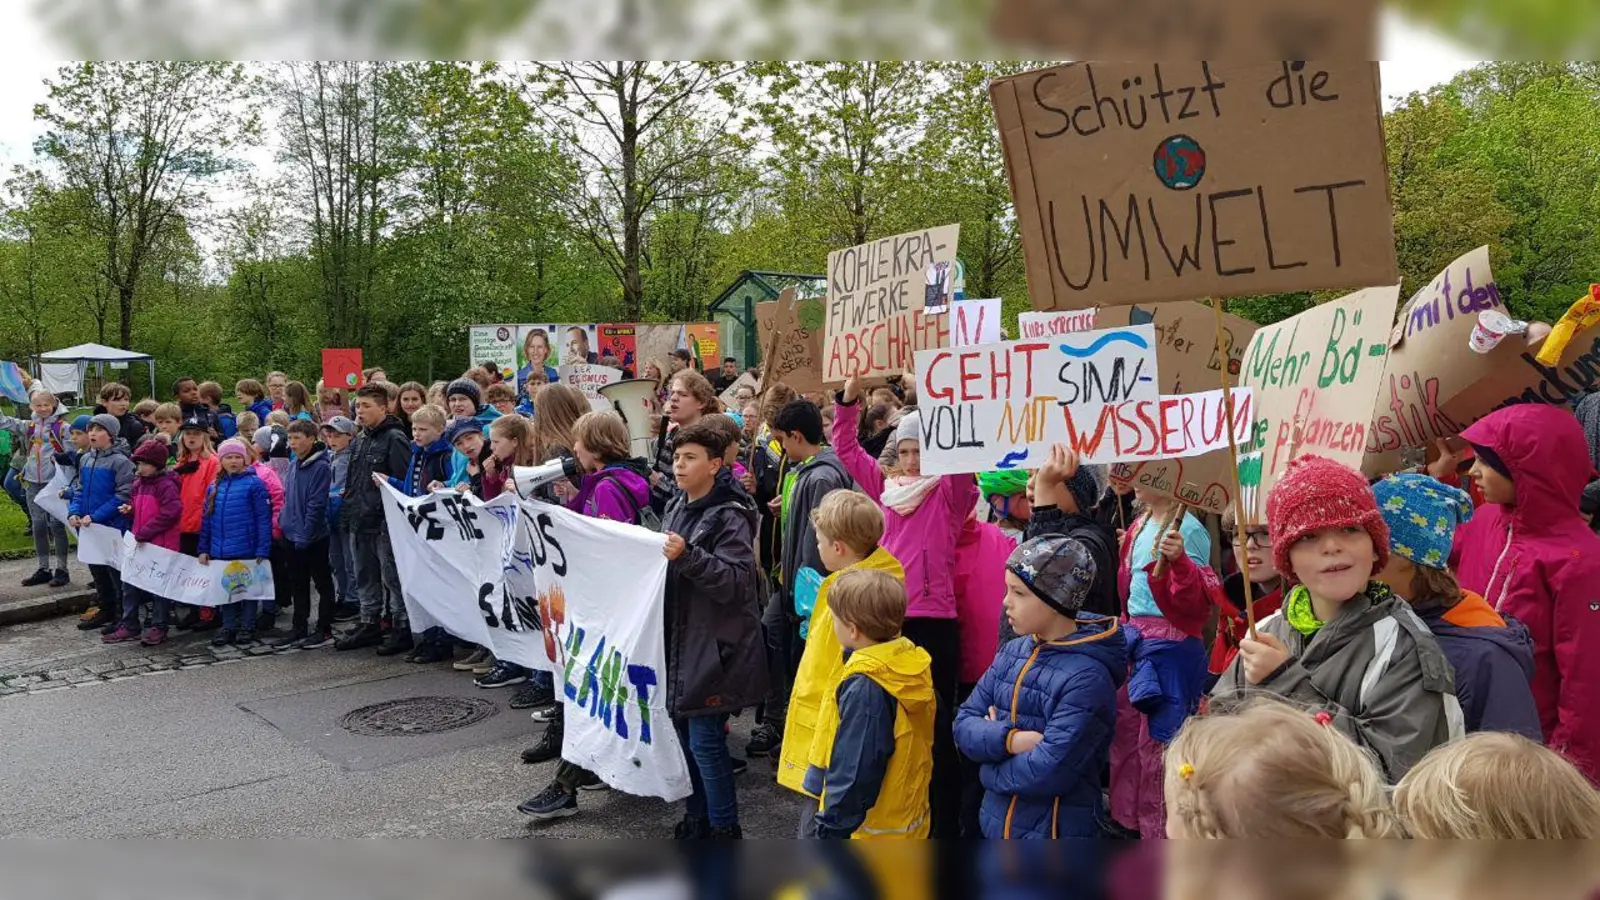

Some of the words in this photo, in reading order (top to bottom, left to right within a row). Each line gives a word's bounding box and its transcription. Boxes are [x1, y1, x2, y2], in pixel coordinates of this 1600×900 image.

[1033, 60, 1226, 139] Schützt
[1266, 60, 1339, 108] die
[1049, 180, 1366, 291] UMWELT
[829, 279, 910, 337] FTWERKE
[1408, 267, 1455, 337] mit
[925, 343, 1050, 405] GEHT
[1244, 318, 1311, 391] Mehr
[919, 403, 985, 451] VOLL
[996, 395, 1059, 444] MIT
[1271, 386, 1365, 476] pflanzen
[1366, 370, 1461, 454] astik
